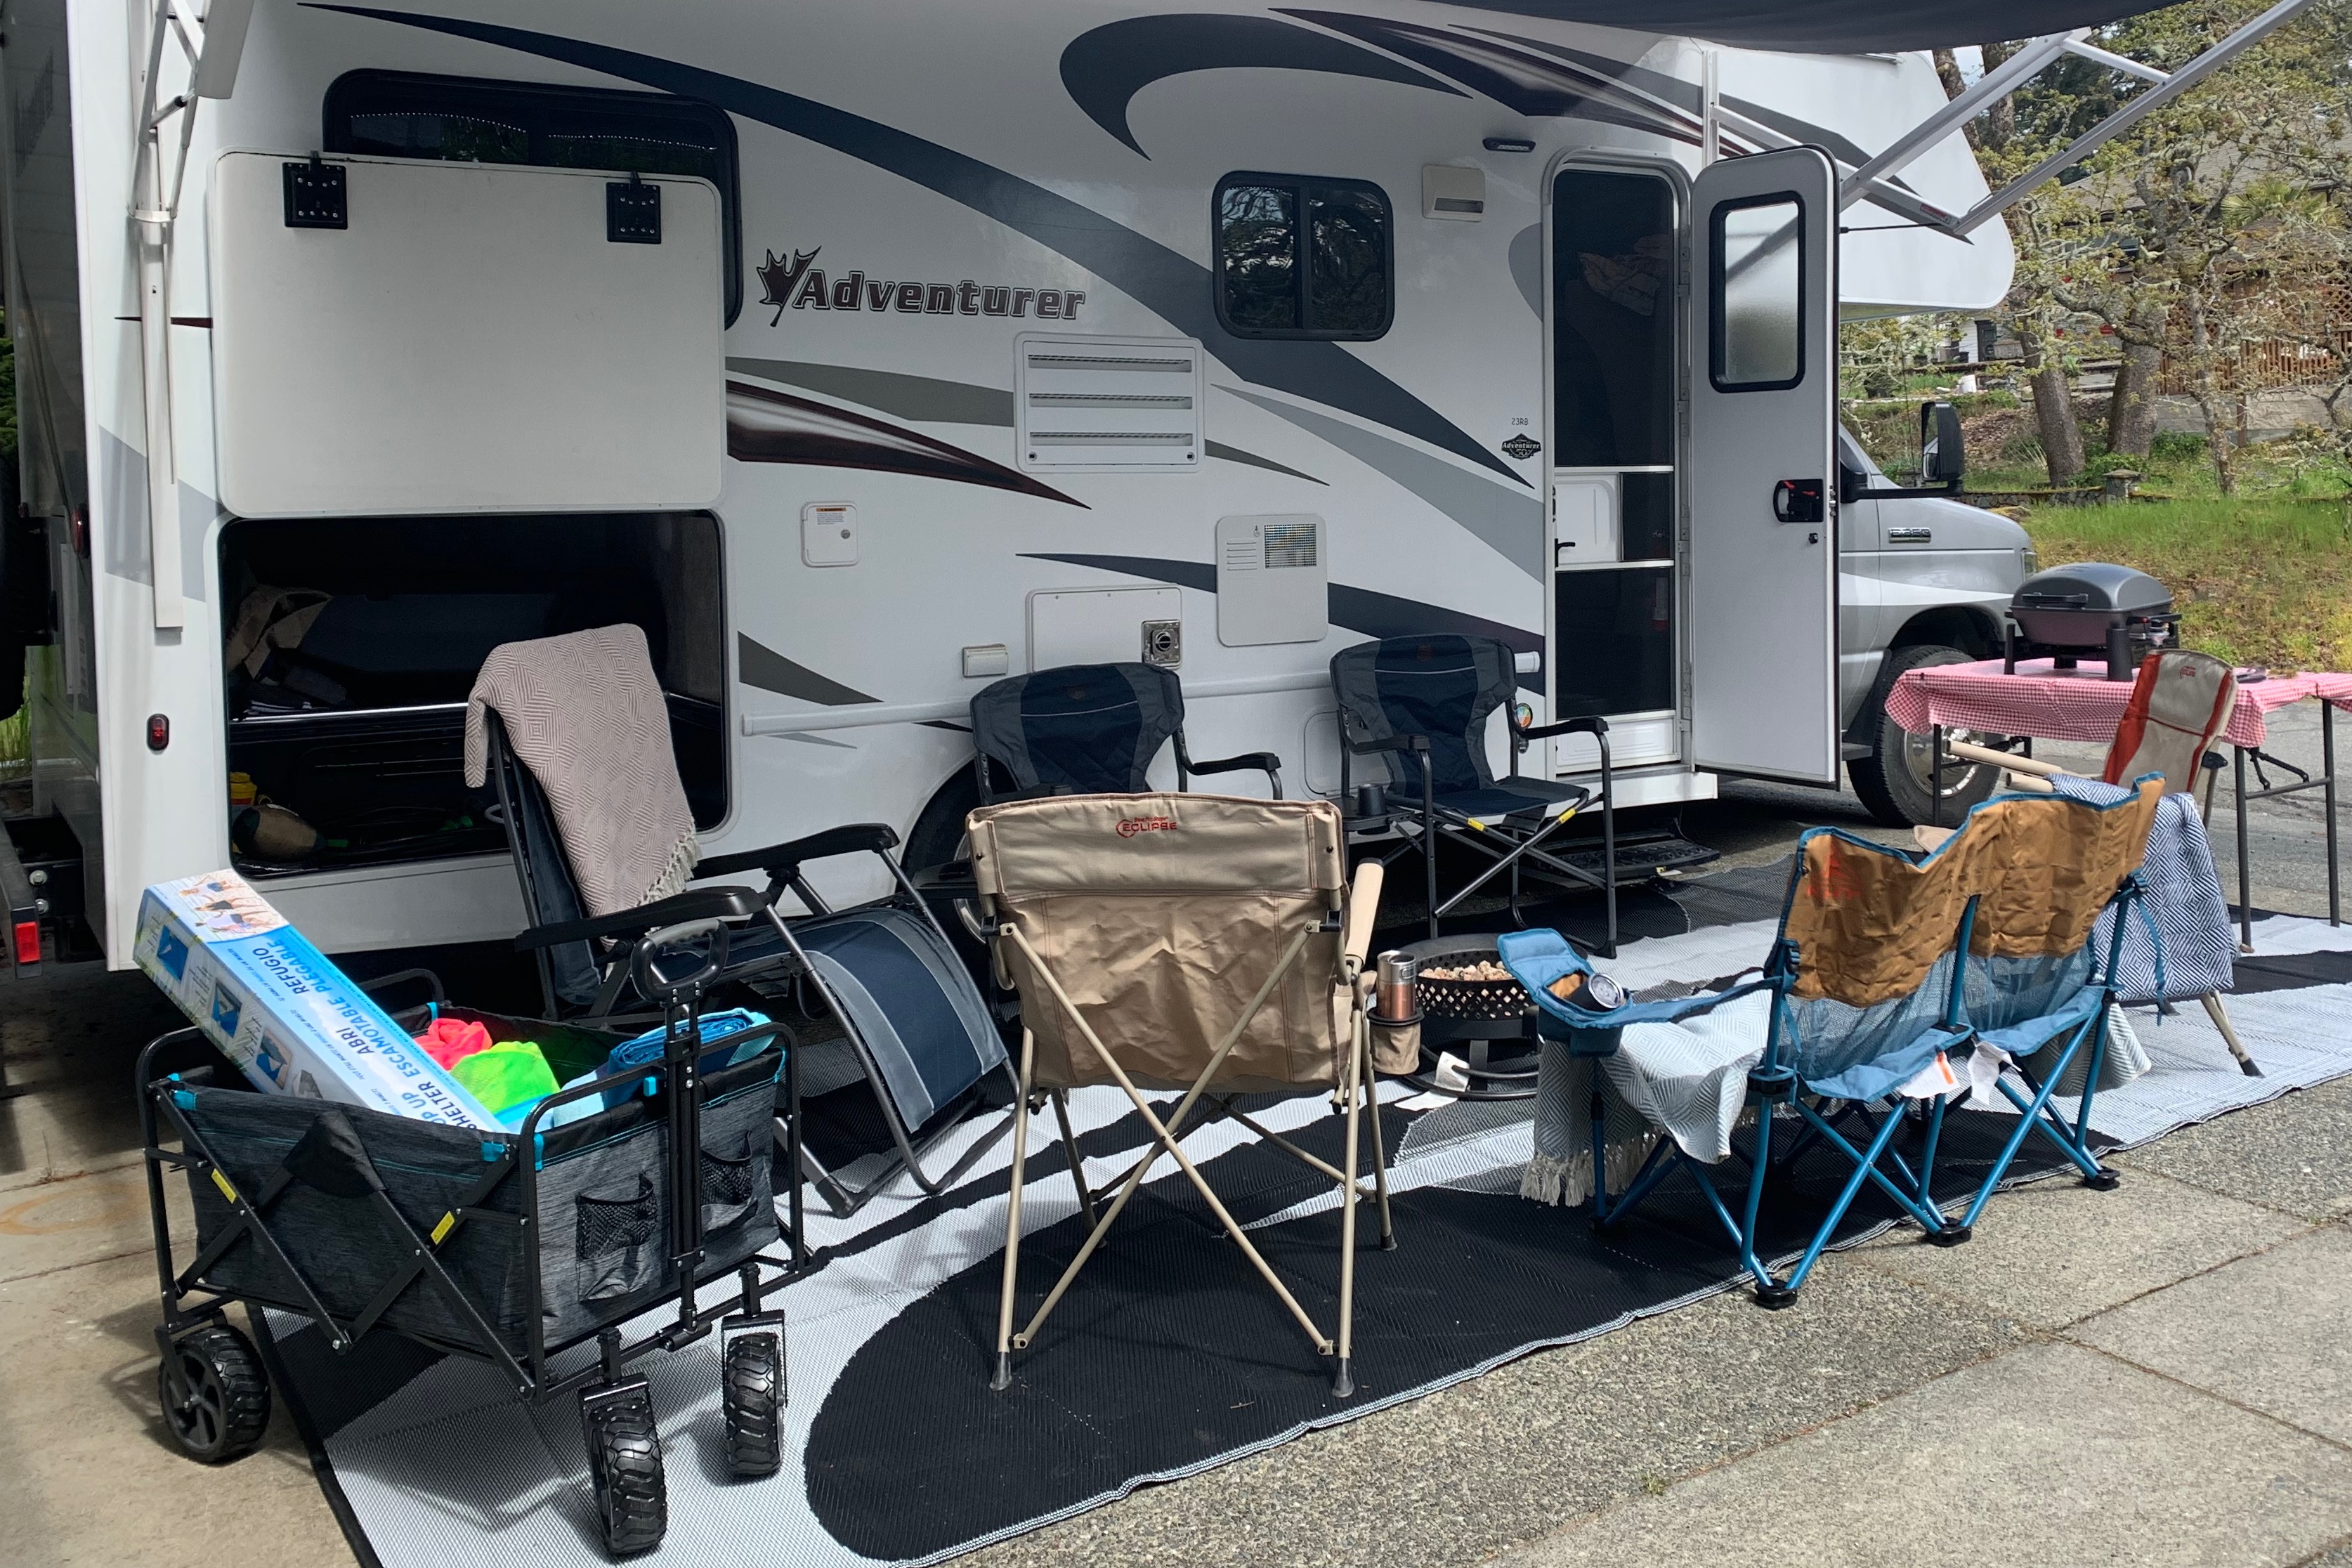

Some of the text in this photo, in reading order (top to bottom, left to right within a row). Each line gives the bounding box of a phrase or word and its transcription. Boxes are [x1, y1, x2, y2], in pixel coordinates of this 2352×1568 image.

[791, 268, 1086, 320] Adventurer
[1511, 417, 1529, 426] 23RB
[1123, 822, 1177, 831] ECLIPSE
[251, 949, 310, 994] REFUGIO
[266, 939, 332, 992] PLEGABLE
[327, 995, 421, 1078] ESCAMOTABLE
[335, 1028, 374, 1053] ABRI
[401, 1092, 447, 1124] OP UP
